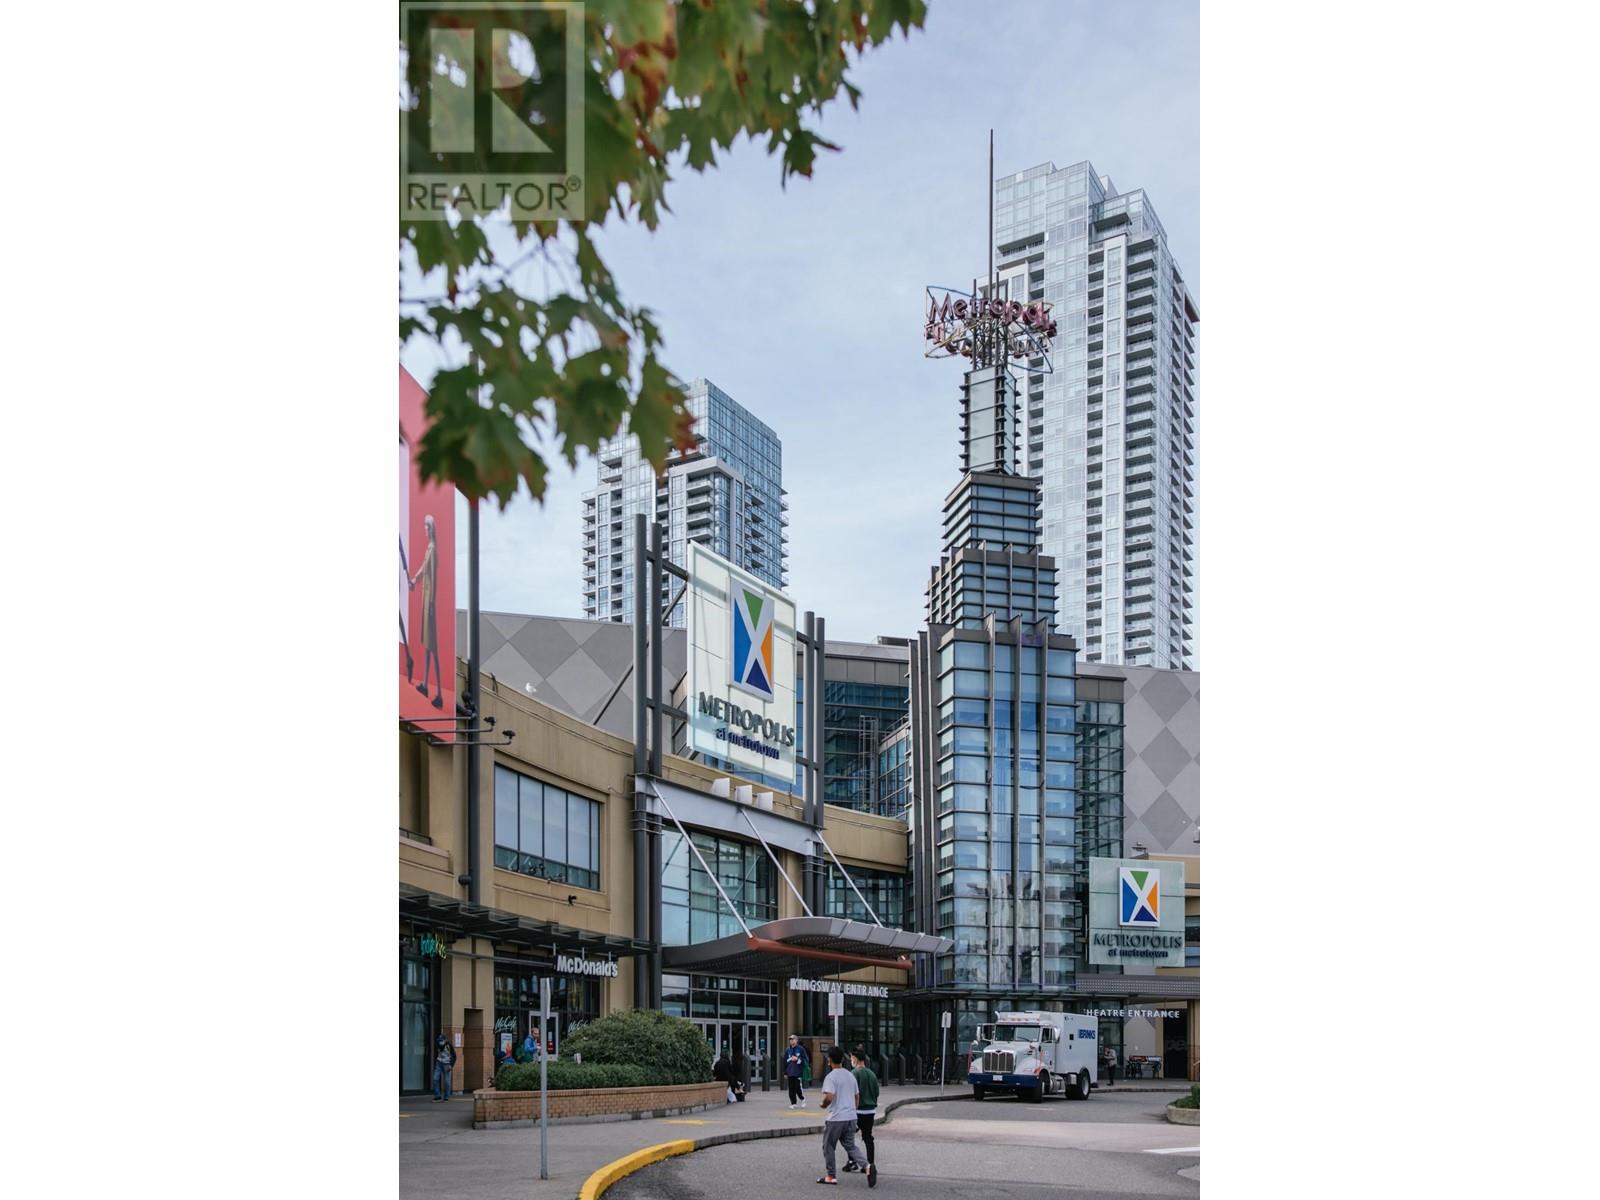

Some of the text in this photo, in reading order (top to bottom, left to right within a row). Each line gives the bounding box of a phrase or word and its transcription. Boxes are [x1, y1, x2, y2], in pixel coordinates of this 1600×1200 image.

[698, 691, 795, 747] METROPOLIS
[715, 727, 780, 760] at metrotown
[1093, 933, 1182, 949] METROPOLIS
[557, 955, 618, 977] McDonald's
[790, 978, 889, 998] KINGSWAY ENTRANCE
[1127, 1009, 1180, 1018] ENTRANCE
